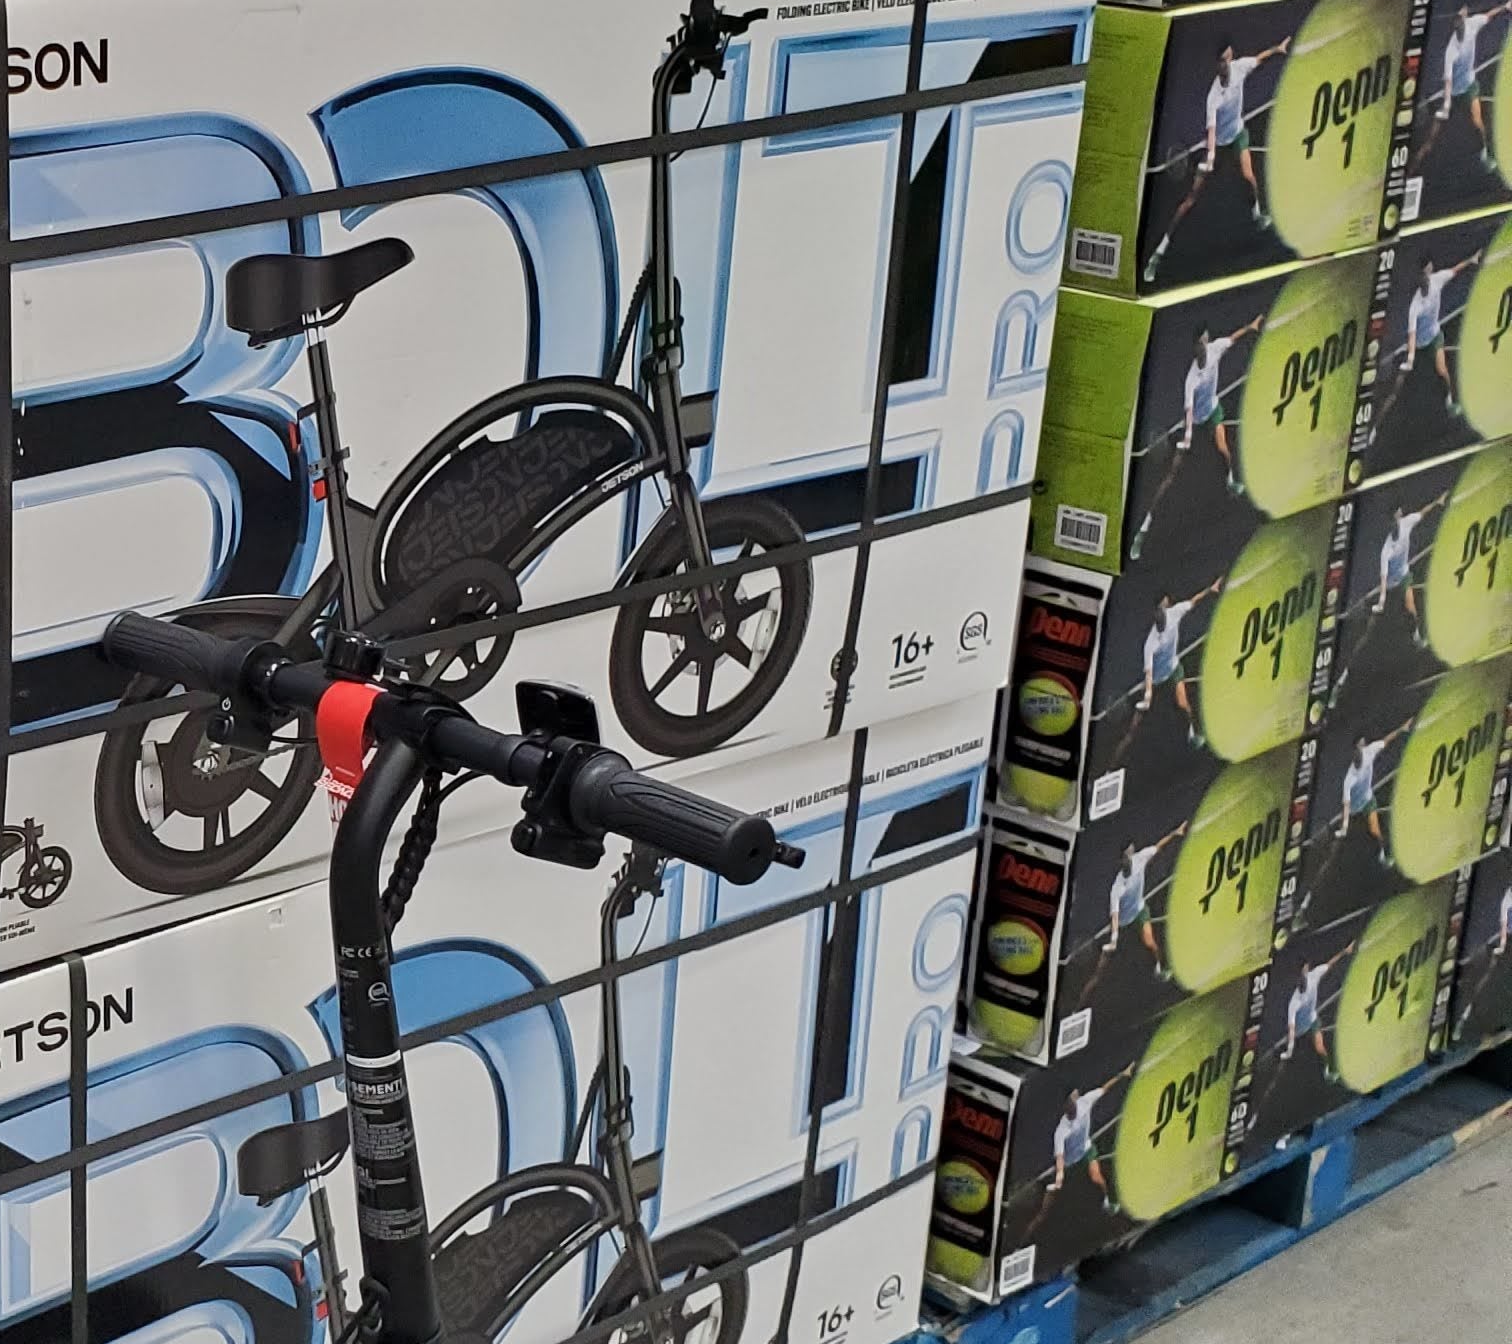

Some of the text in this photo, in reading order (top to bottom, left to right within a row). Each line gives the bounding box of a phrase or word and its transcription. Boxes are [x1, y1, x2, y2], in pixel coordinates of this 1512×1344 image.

[777, 5, 811, 20] FOLDING
[813, 0, 850, 16] ELECTRIC
[1301, 54, 1391, 159] Penn
[1342, 123, 1355, 170] 1
[1272, 319, 1358, 428] Penn
[601, 460, 644, 493] JETSON
[892, 631, 934, 668] 16+
[1232, 569, 1318, 680] Penn
[1421, 712, 1499, 808] Penn
[1198, 807, 1283, 914] Penn
[1364, 925, 1438, 1023] Penn
[1148, 1039, 1234, 1150] Penn
[817, 1306, 855, 1339] 16+
